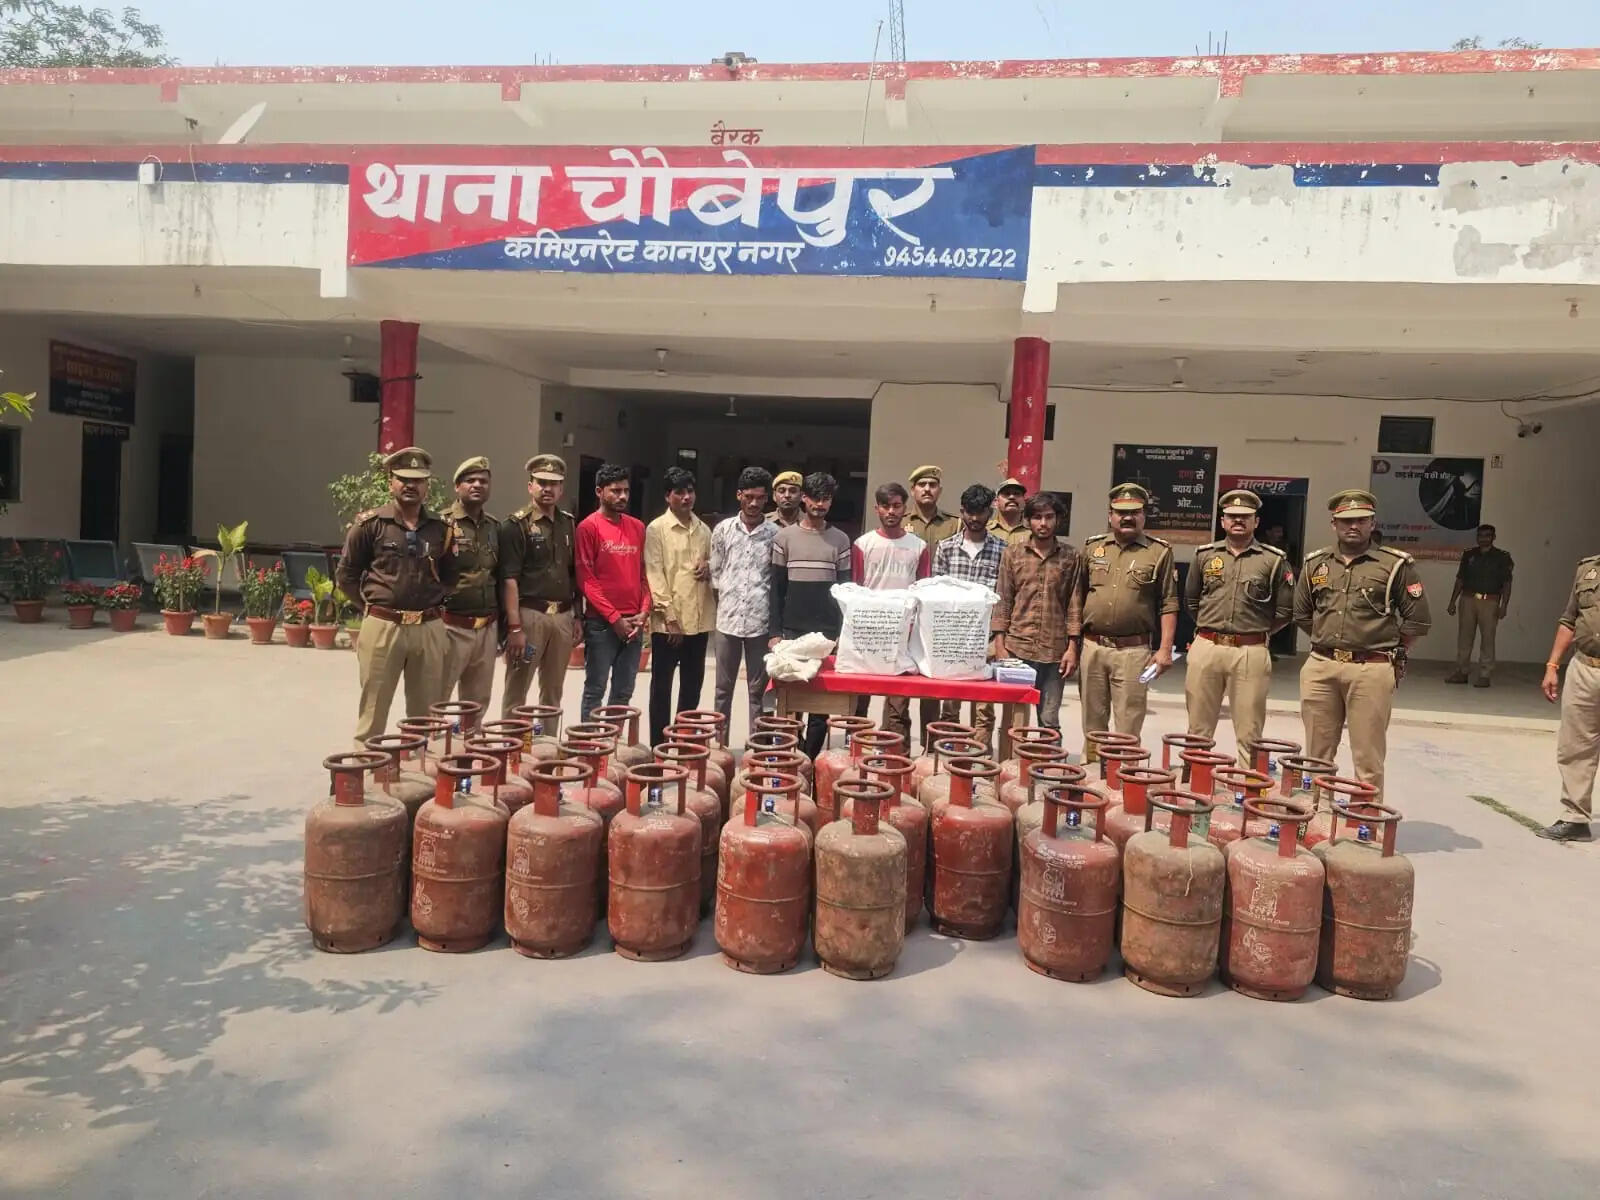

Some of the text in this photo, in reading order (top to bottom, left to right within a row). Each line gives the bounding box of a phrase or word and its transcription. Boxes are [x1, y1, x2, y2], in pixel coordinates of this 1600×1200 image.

[710, 119, 763, 146] बैरक
[362, 162, 553, 226] थाना
[504, 228, 806, 274] कमिश्नरेट कानपुर नगर
[883, 245, 1017, 268] 9454403722
